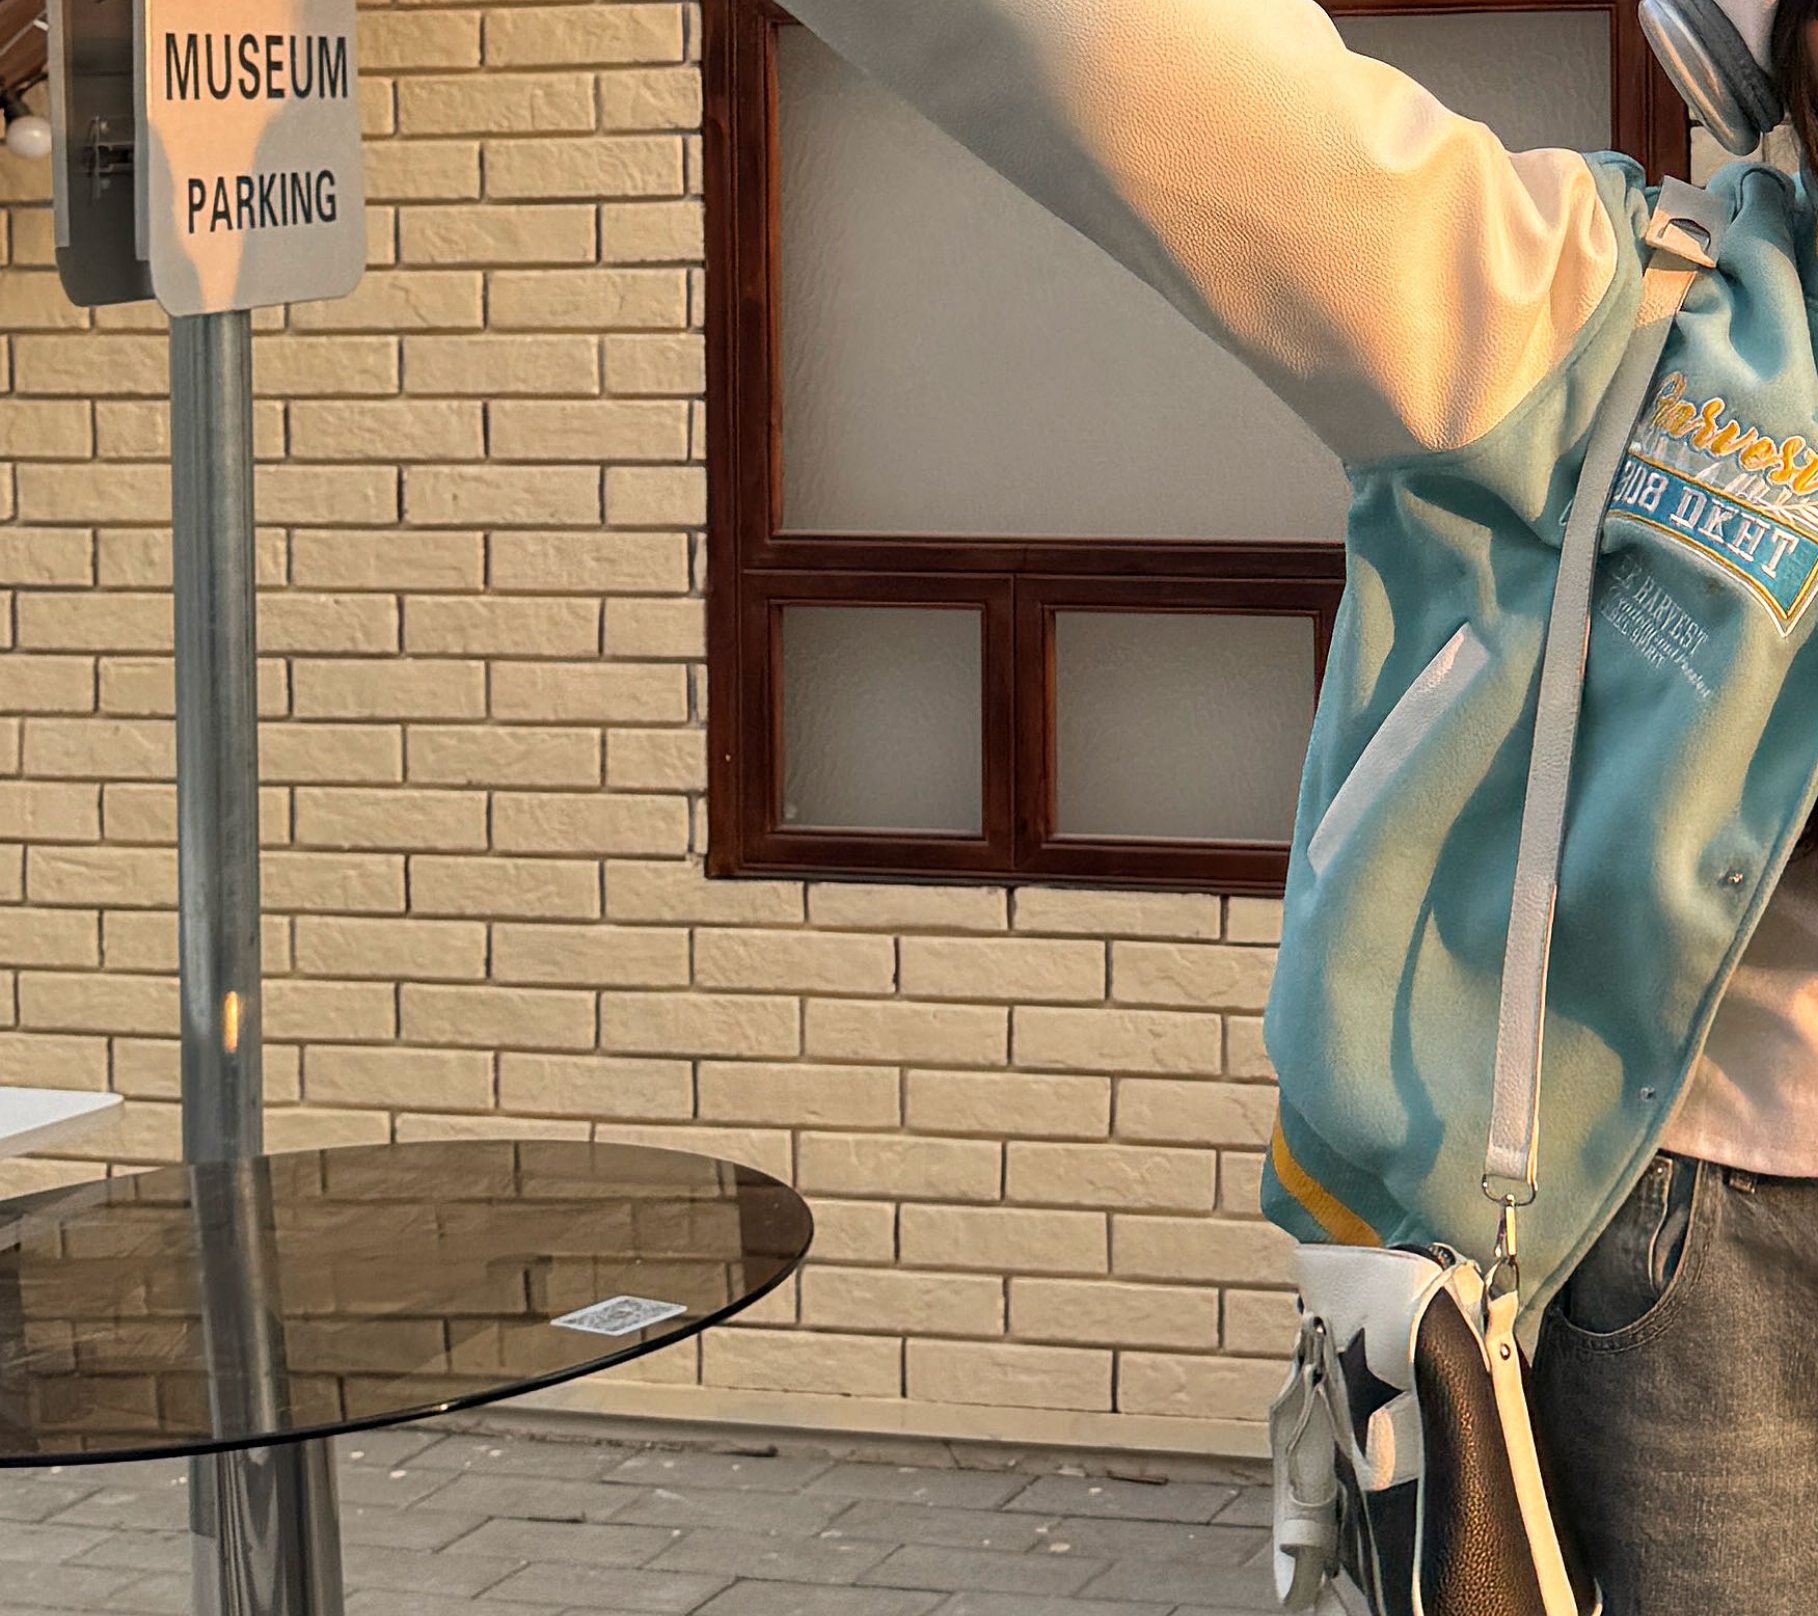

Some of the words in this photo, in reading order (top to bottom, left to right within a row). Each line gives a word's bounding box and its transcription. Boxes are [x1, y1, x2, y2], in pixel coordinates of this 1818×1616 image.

[165, 32, 348, 100] MUSEUM
[187, 169, 337, 234] PARKING
[1669, 485, 1799, 579] DKHT
